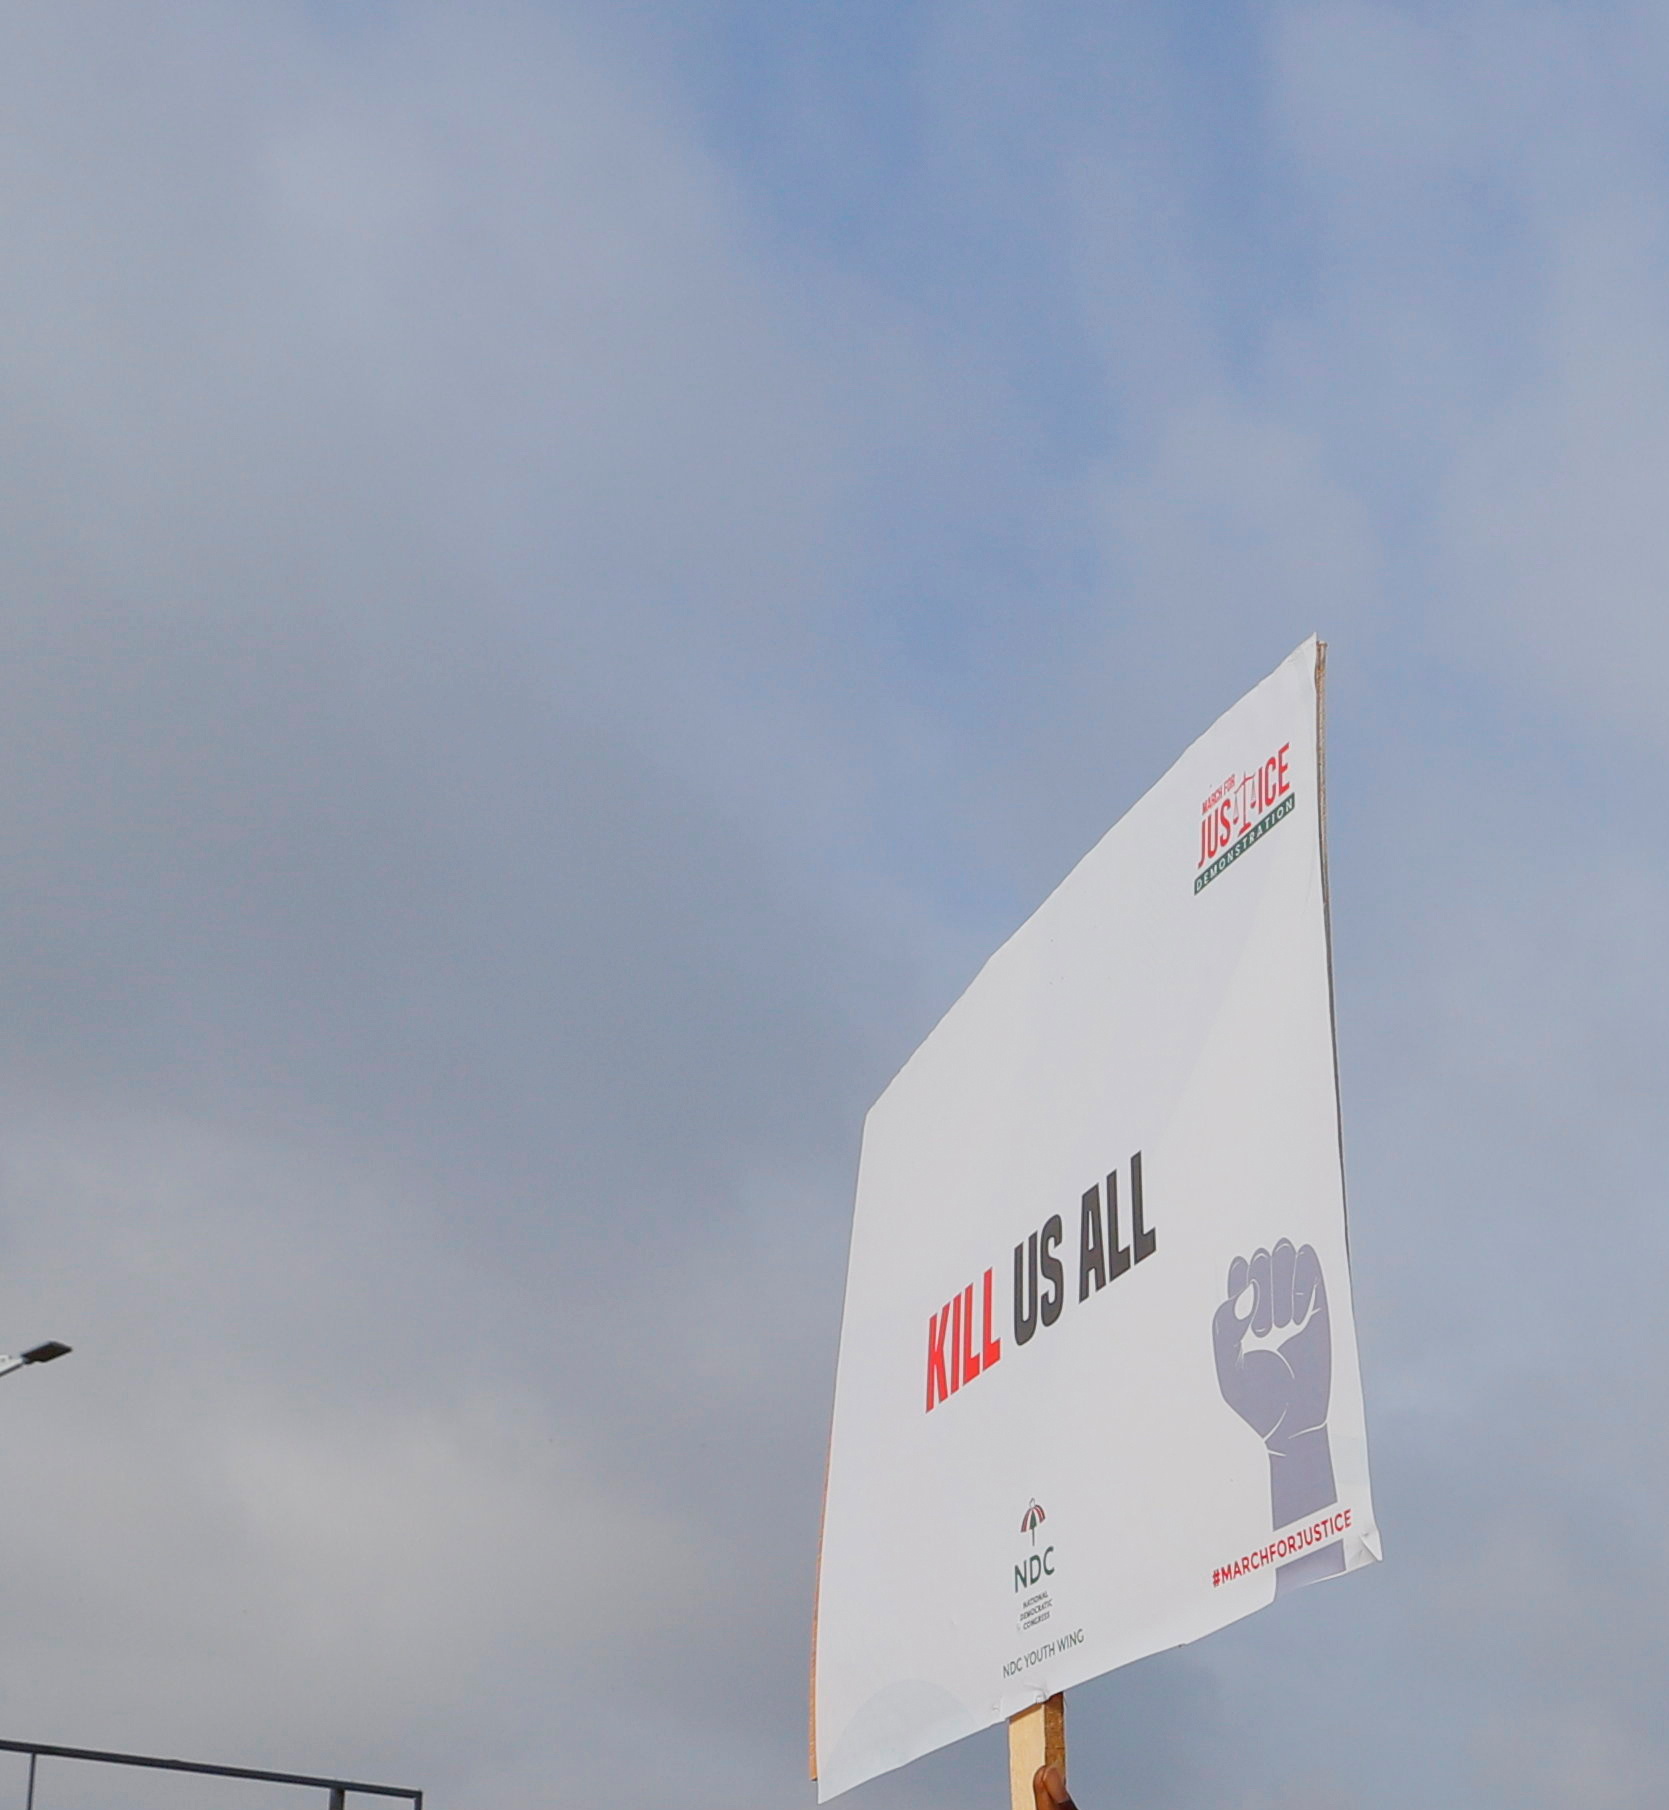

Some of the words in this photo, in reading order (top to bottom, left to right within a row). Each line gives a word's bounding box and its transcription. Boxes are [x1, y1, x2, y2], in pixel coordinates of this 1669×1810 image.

[1196, 797, 1294, 893] DEMONSTRATION
[925, 1267, 1002, 1414] KILL
[1013, 1213, 1064, 1346] US
[1079, 1151, 1157, 1303] ALL
[1014, 1546, 1056, 1593] NDC
[1212, 1508, 1352, 1588] #MARCHFORJUSTICE
[1002, 1657, 1023, 1679] NDC
[1024, 1641, 1056, 1669] YOUTH
[1057, 1628, 1085, 1655] WING
